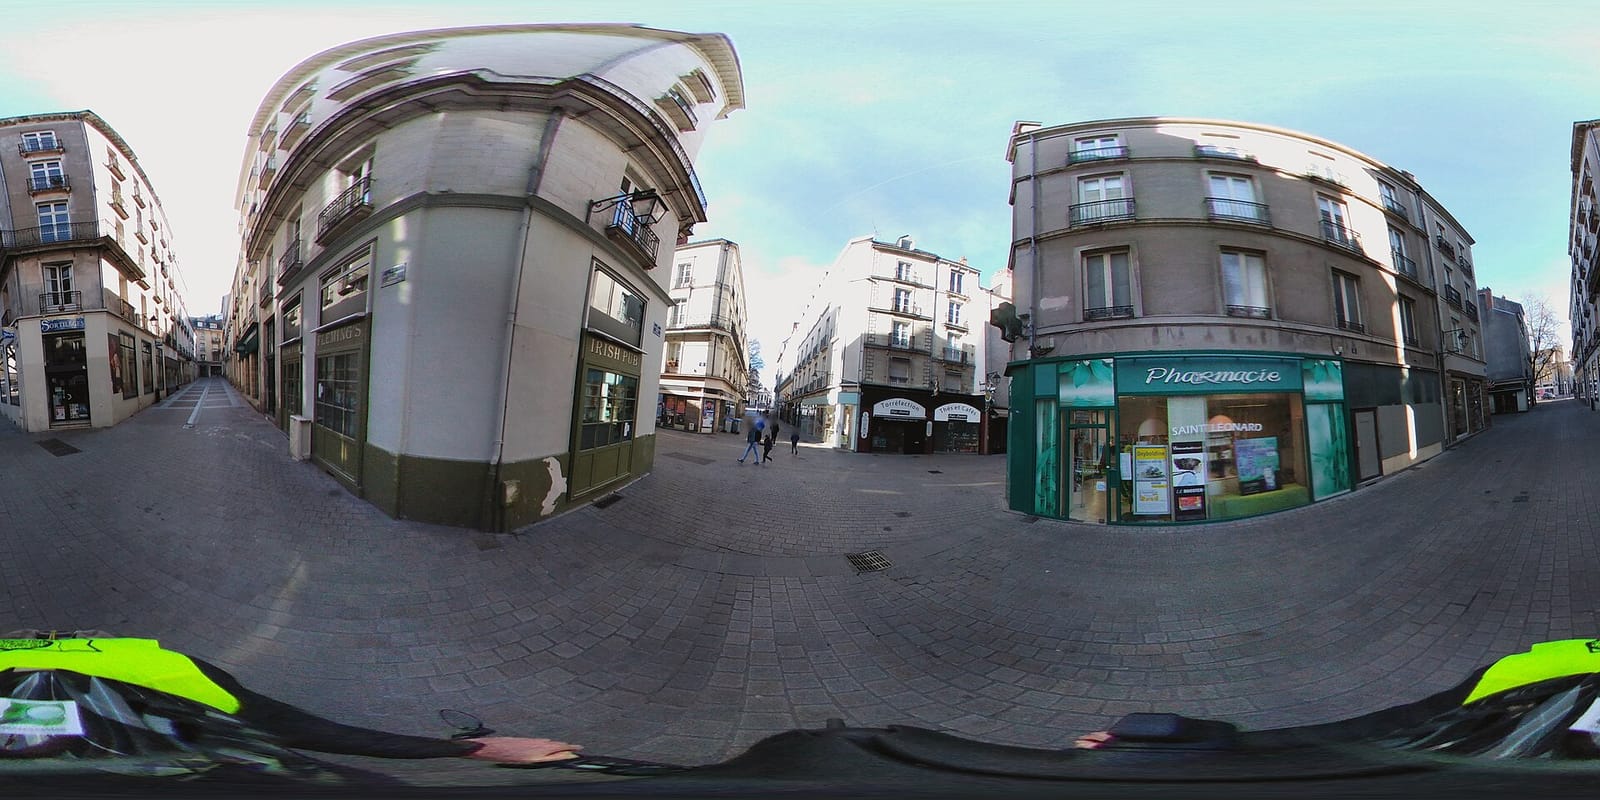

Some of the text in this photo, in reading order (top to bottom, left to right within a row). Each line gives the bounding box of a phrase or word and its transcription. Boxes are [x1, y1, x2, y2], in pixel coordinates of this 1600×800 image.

[591, 339, 639, 367] IRISH PUB
[1145, 367, 1282, 385] Pharmacie
[1172, 424, 1206, 436] SAINT
